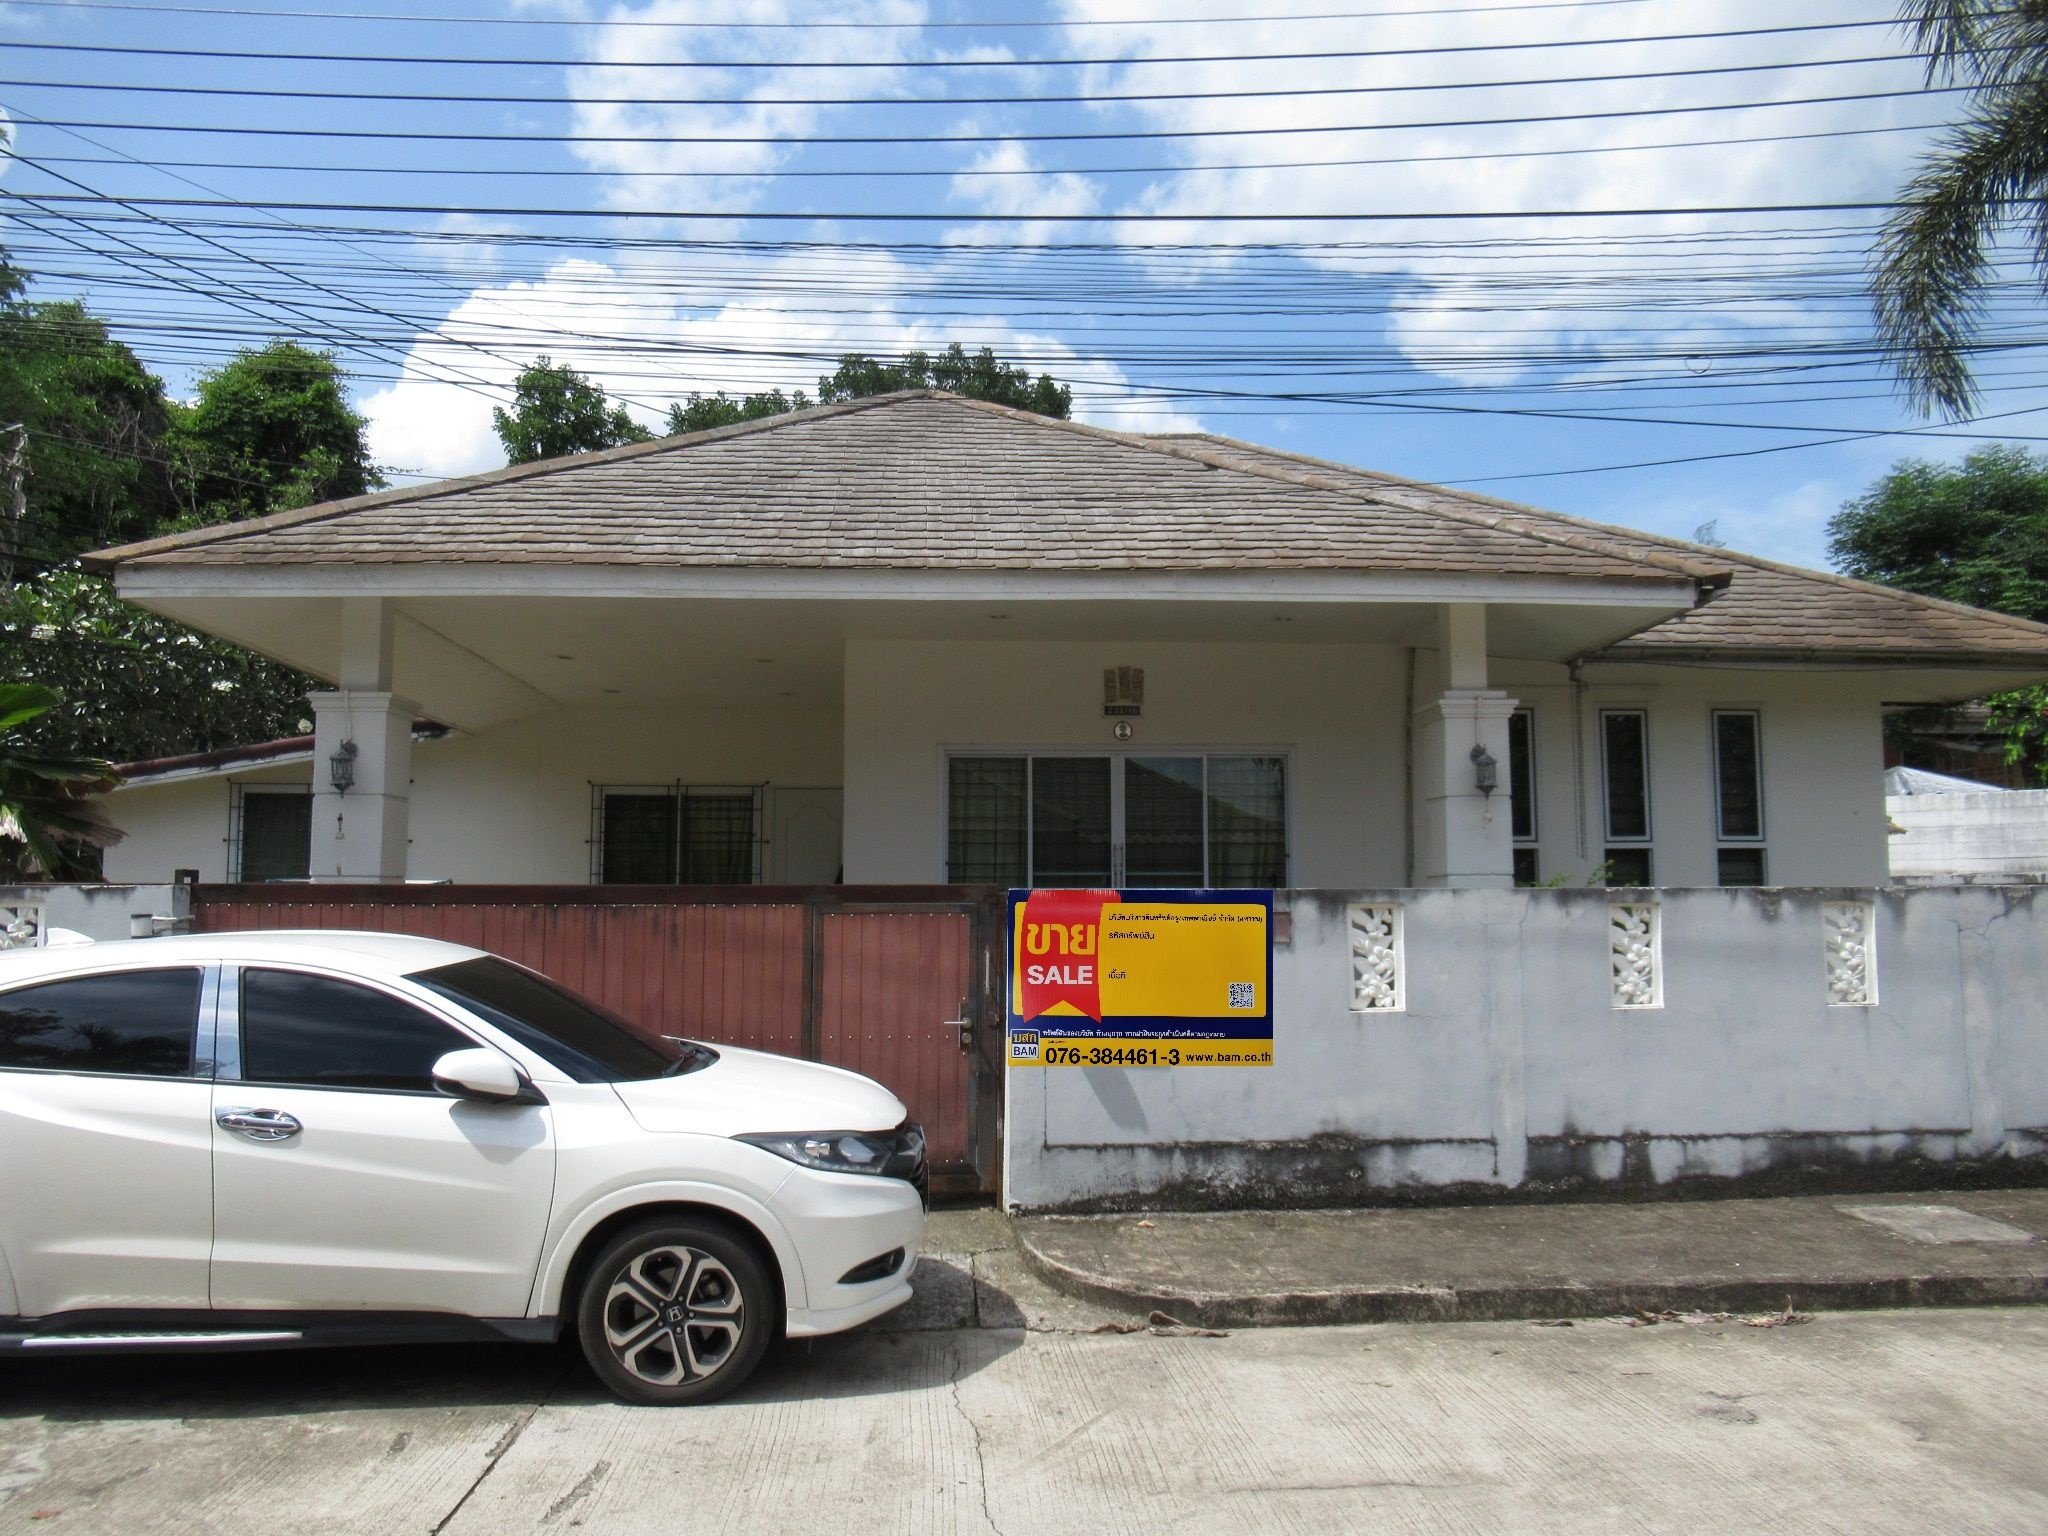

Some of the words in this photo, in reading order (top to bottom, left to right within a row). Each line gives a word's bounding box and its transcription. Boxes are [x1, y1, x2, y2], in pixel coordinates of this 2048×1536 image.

[1026, 923, 1096, 955] ขาย
[1027, 964, 1093, 985] SALE
[1013, 1046, 1037, 1056] BAM
[1045, 1047, 1181, 1065] 076-384461-3
[1185, 1052, 1271, 1062] www.bam.co.th
